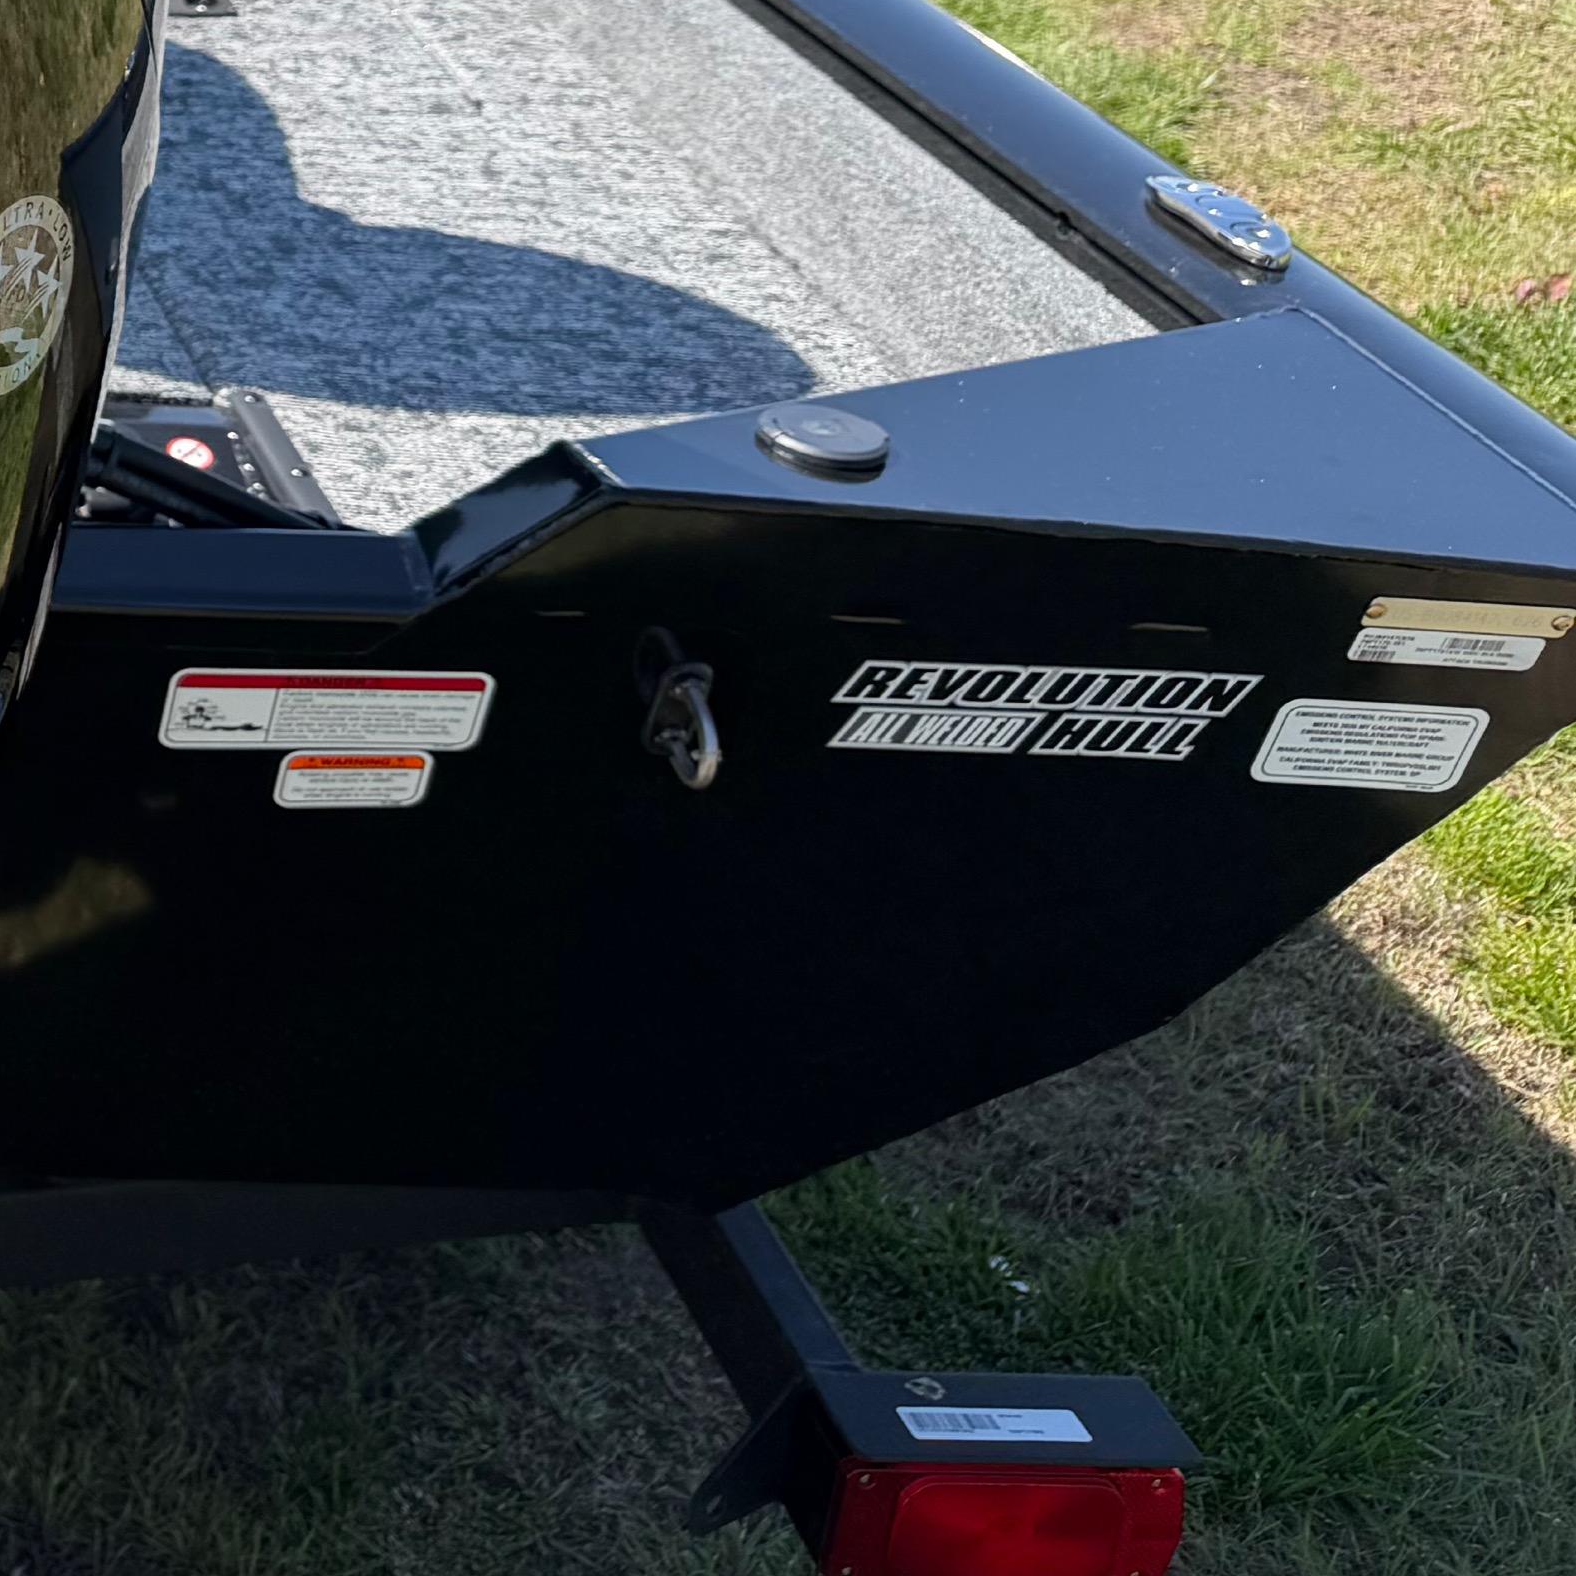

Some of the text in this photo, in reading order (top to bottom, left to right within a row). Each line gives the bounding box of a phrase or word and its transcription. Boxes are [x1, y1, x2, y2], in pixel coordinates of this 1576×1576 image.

[844, 664, 1250, 714] REVOLUTION
[847, 712, 1199, 757] ALL WELDED HULL
